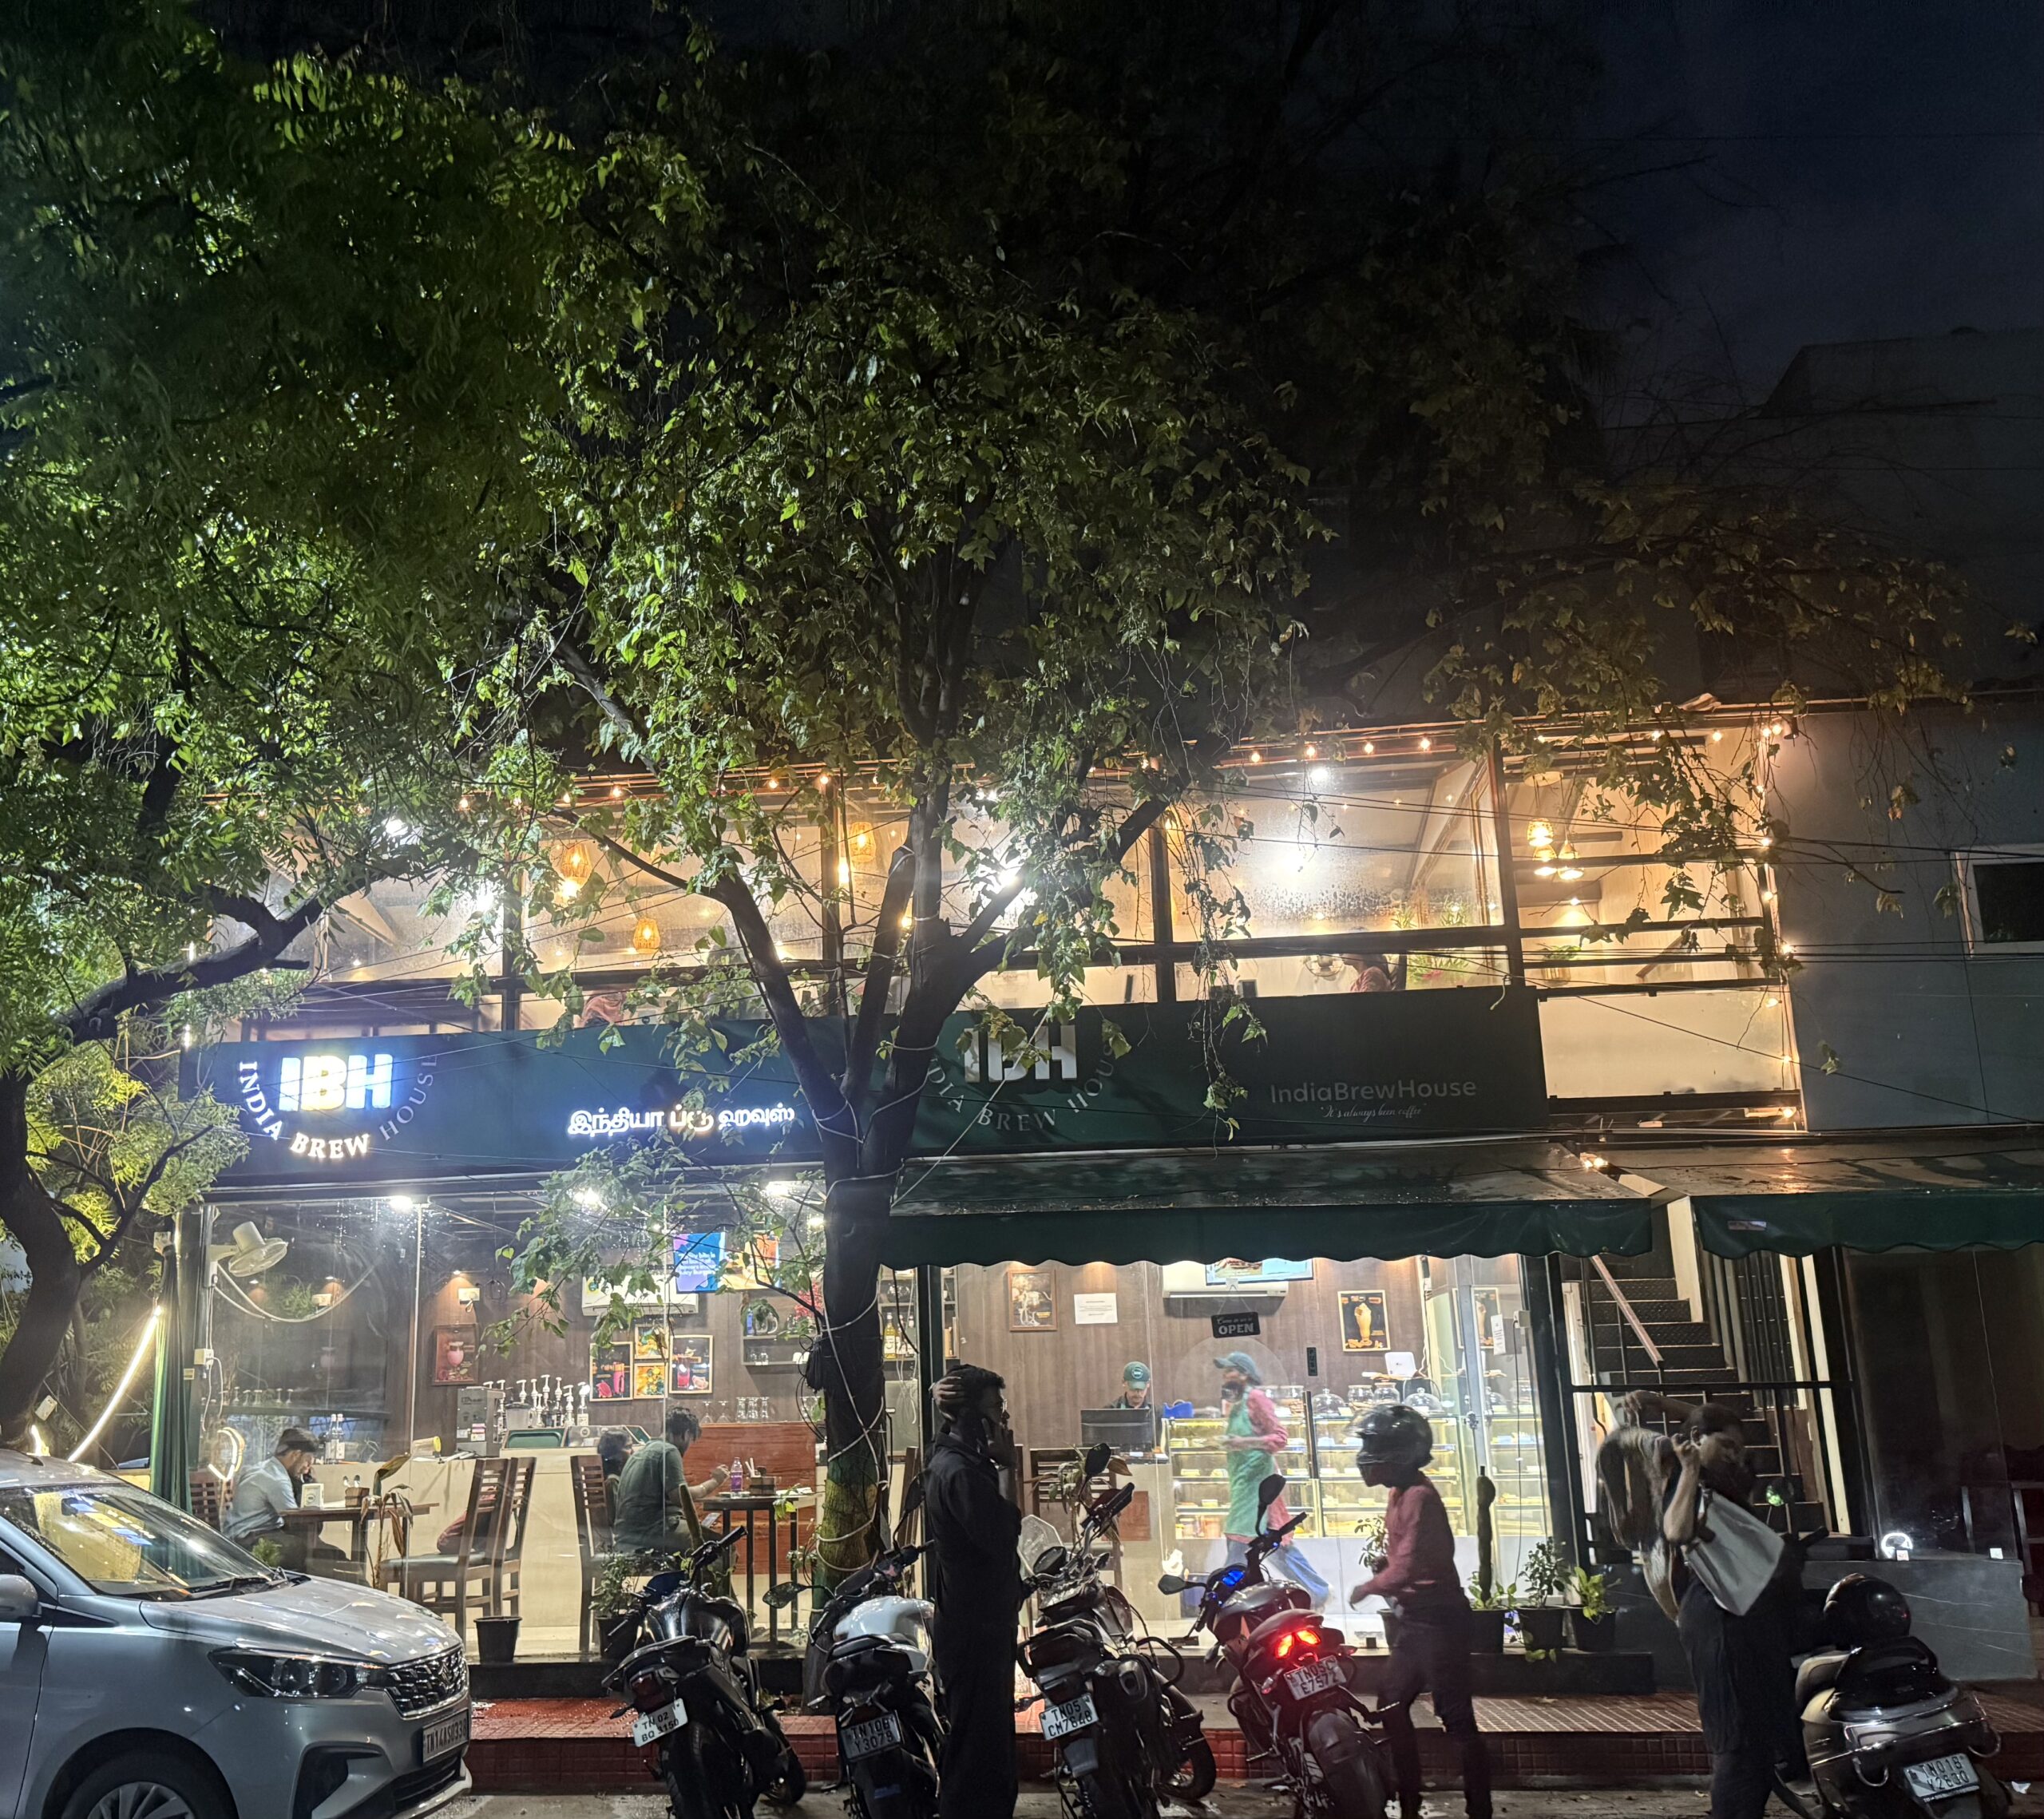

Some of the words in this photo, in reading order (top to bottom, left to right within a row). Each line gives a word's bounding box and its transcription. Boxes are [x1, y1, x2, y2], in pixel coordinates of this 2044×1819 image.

[279, 1053, 393, 1112] IBH
[927, 1057, 964, 1113] DIA
[978, 1107, 1056, 1131] BREW
[1067, 1044, 1115, 1113] HOU
[1270, 1080, 1476, 1104] IndiaBrewHouse
[239, 1061, 283, 1140] INDIA
[289, 1131, 371, 1159] BREW
[568, 1107, 665, 1137] இந்தியா
[1218, 1322, 1254, 1334] OPEN
[642, 1717, 656, 1730] TN
[657, 1711, 669, 1722] 02
[1051, 1700, 1081, 1722] TN05
[642, 1730, 656, 1742] BQ
[854, 1730, 894, 1753] Y3079
